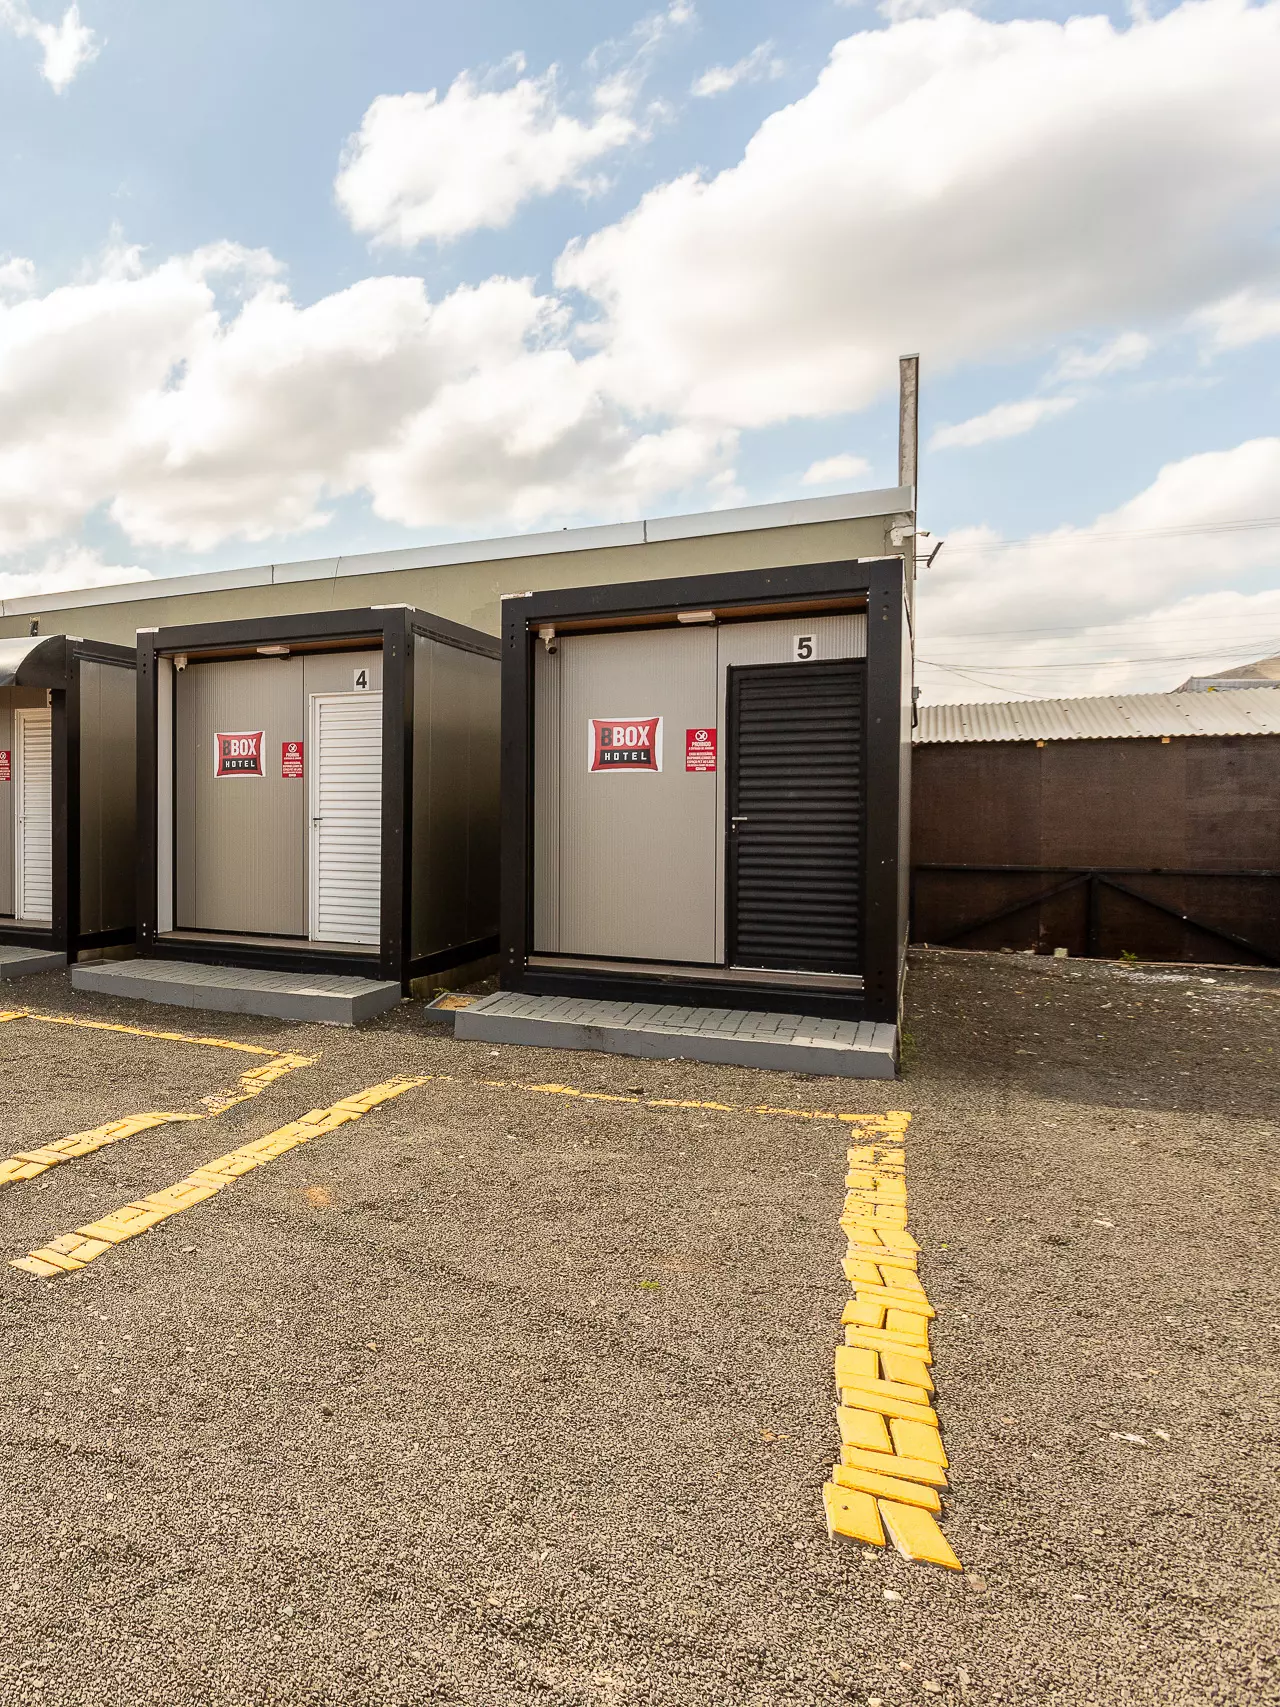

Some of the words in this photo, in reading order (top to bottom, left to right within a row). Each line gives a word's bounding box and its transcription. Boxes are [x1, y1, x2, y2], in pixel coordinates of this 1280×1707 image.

[797, 636, 813, 660] 5
[355, 670, 367, 689] 4
[604, 752, 647, 761] HOTEL
[225, 760, 256, 768] HOTEL
